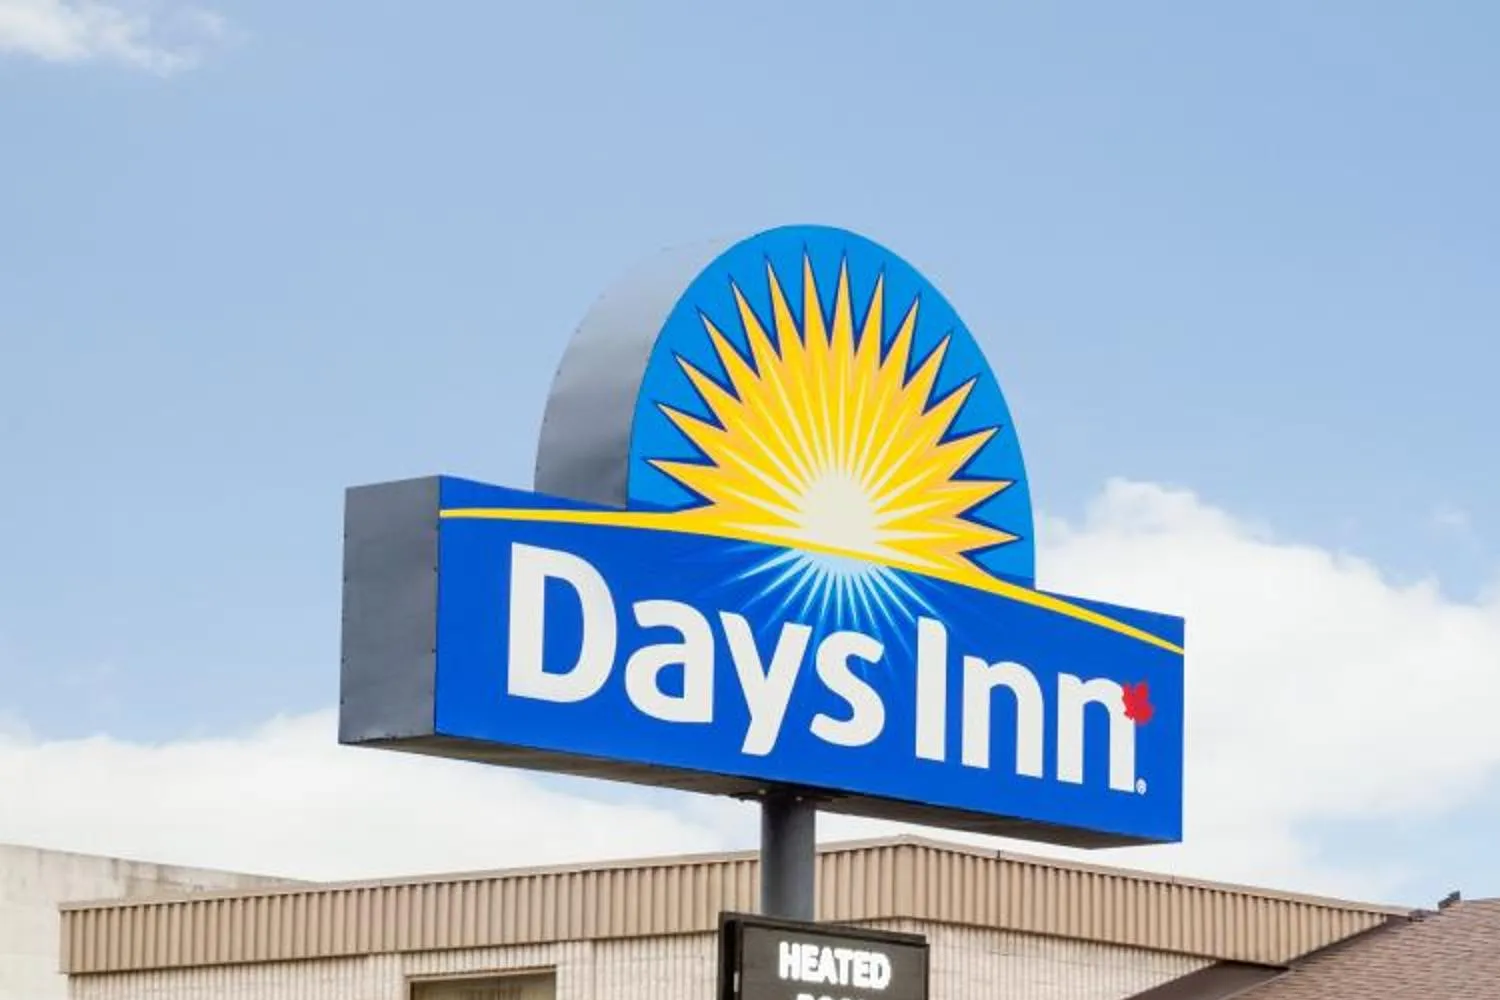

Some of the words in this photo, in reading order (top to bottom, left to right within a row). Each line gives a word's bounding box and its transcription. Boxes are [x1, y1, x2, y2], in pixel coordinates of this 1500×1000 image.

[508, 543, 886, 756] Days
[916, 617, 1138, 793] Inn
[778, 941, 891, 990] HEATED
